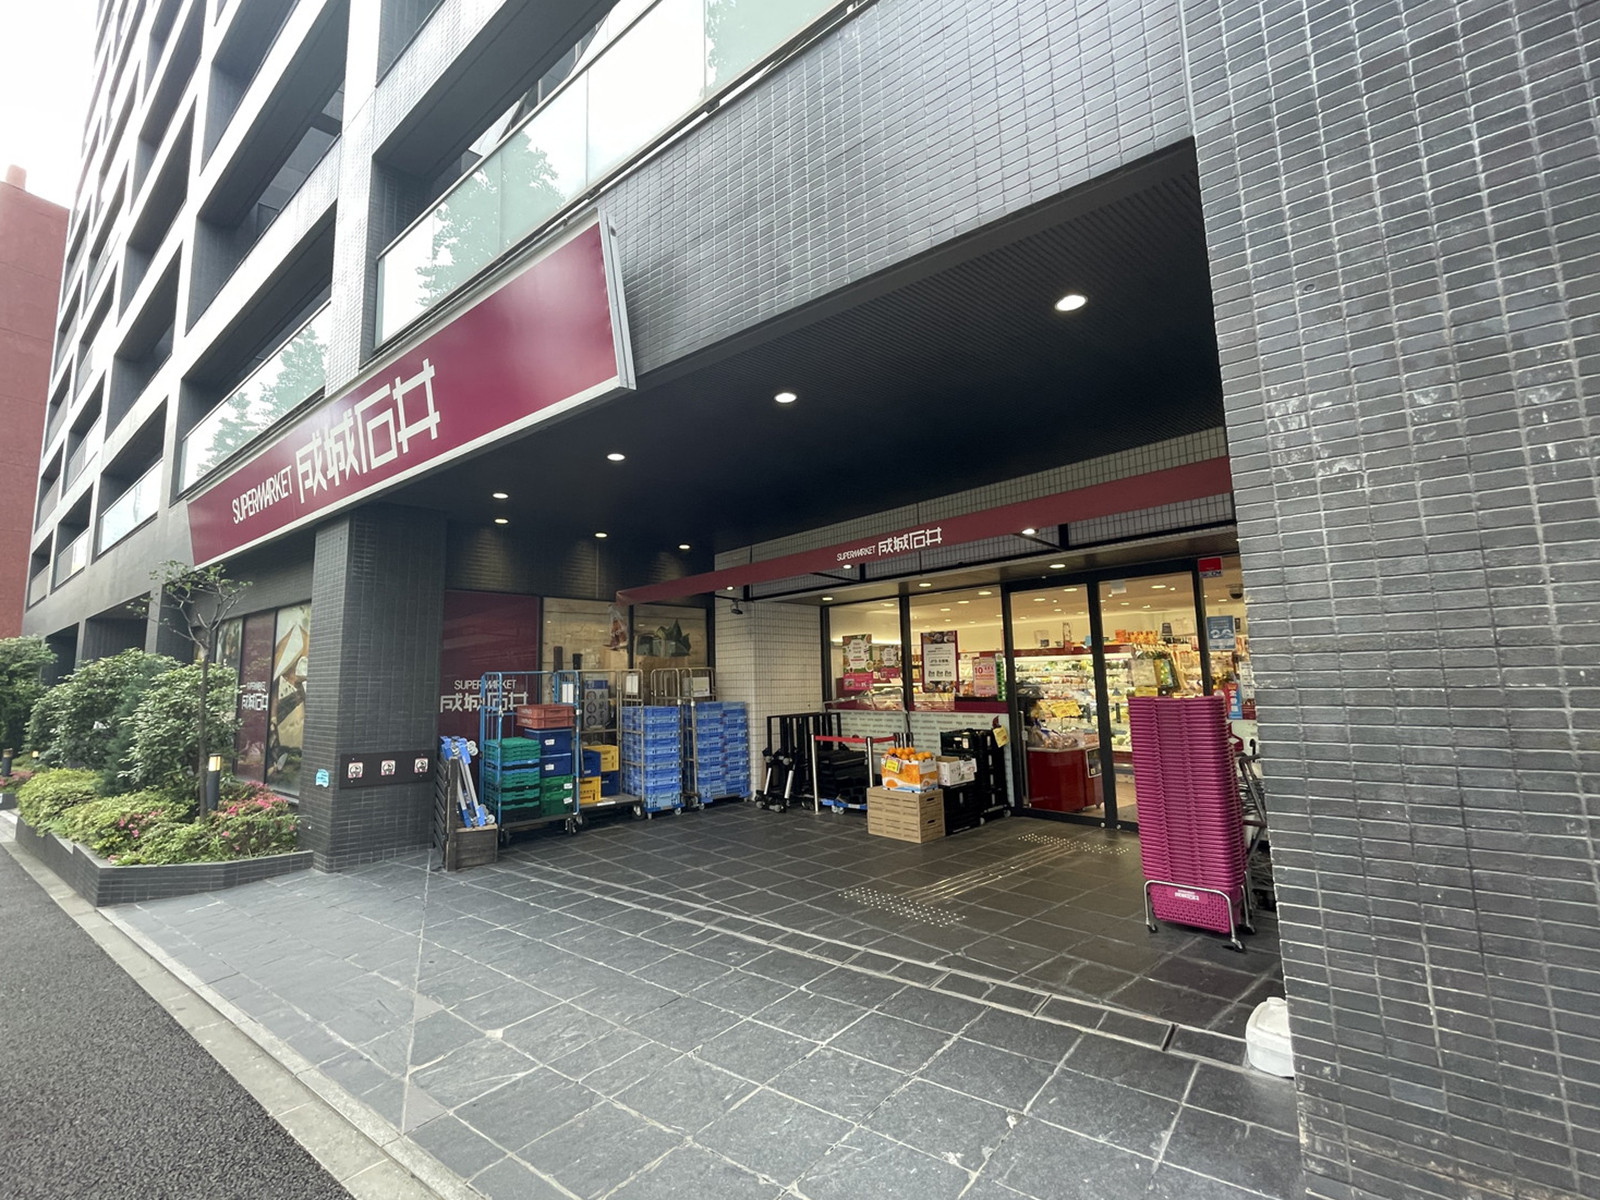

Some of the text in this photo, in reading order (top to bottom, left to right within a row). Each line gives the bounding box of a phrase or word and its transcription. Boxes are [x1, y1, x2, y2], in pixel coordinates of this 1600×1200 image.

[231, 358, 441, 524] SUPERMARKET 成城石井
[836, 526, 942, 562] SUPERMARKET 成城石井
